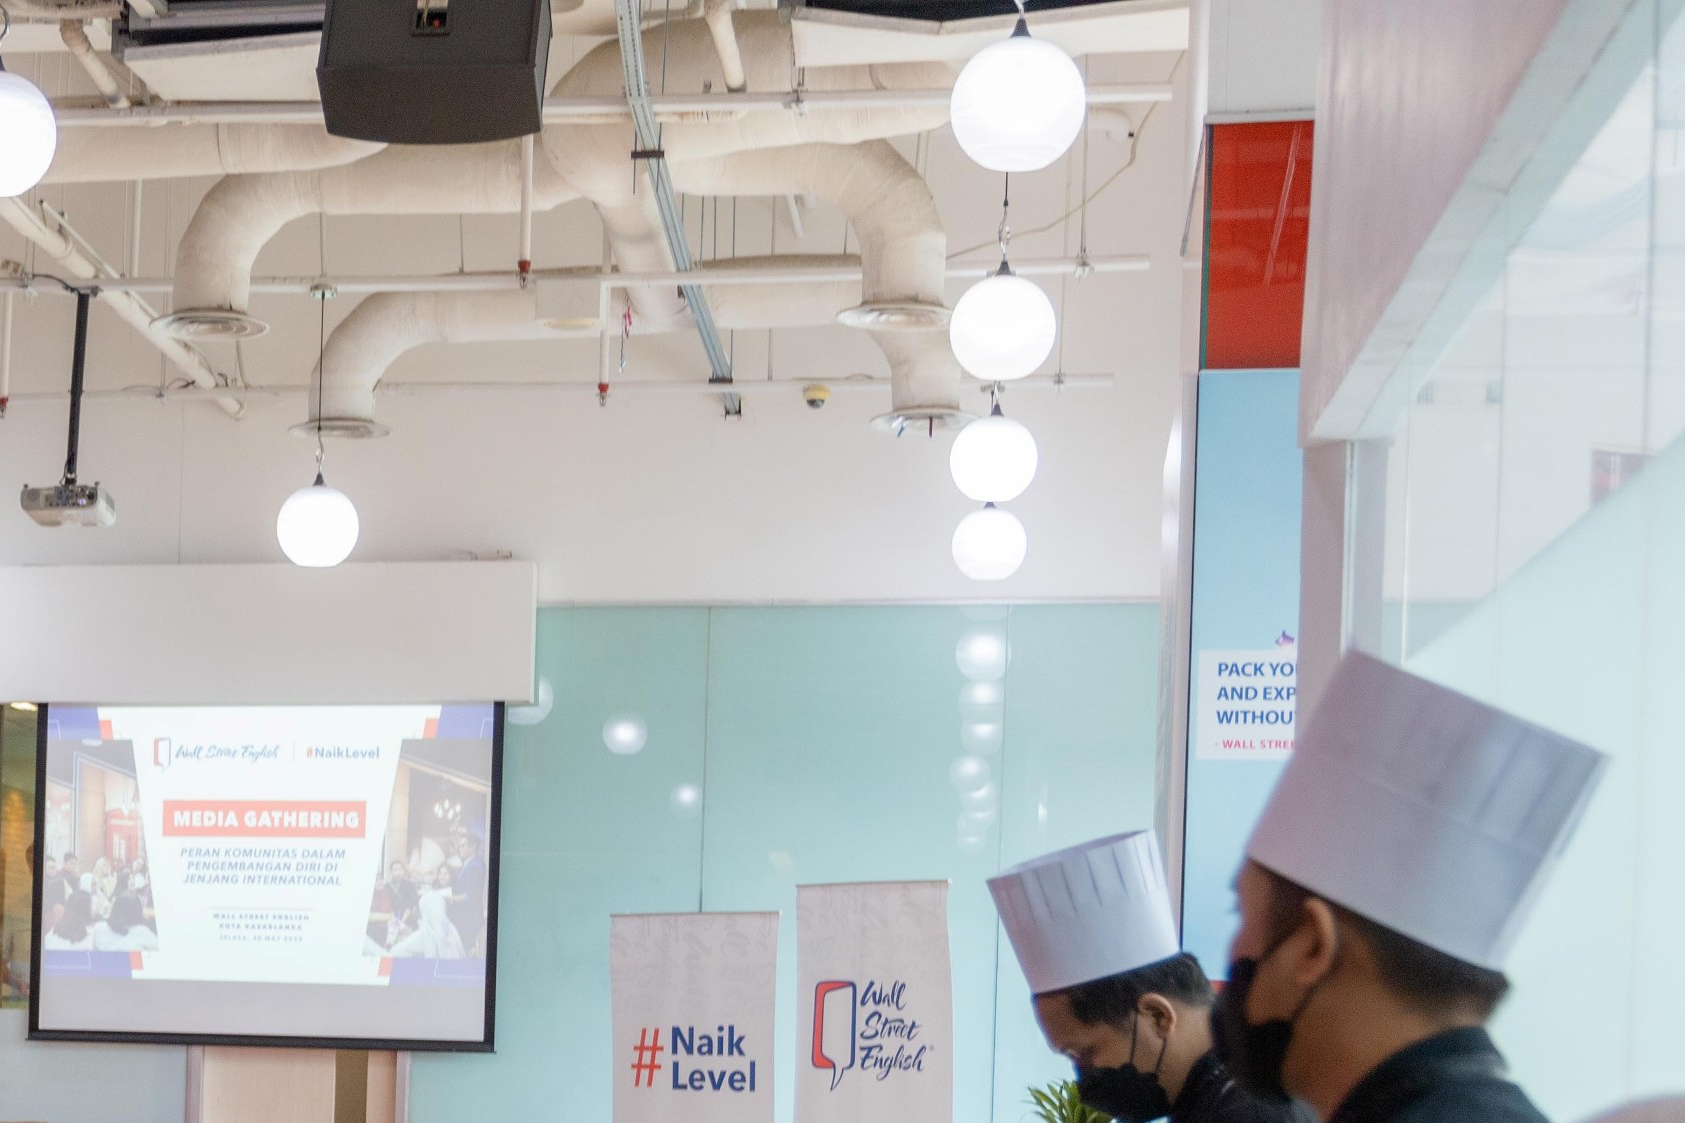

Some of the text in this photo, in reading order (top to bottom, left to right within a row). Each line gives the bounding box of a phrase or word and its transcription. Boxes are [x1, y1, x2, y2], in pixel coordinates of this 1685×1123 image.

[1217, 662, 1297, 677] PACK YO
[1216, 686, 1258, 701] AND
[1216, 710, 1295, 725] WITHOU
[1222, 739, 1255, 750] WALL
[173, 810, 360, 828] MEDIA GATHERING
[180, 848, 346, 859] PERAN KOMUNITAS DALAM
[187, 861, 338, 872] PENGEMBANGAN DIRI DI
[182, 874, 342, 886] JENJANG INTERNATIONAL
[860, 980, 907, 1010] Wall
[860, 1011, 919, 1041] Street
[671, 1024, 747, 1057] Naik
[860, 1045, 925, 1081] English
[671, 1061, 757, 1093] Level
